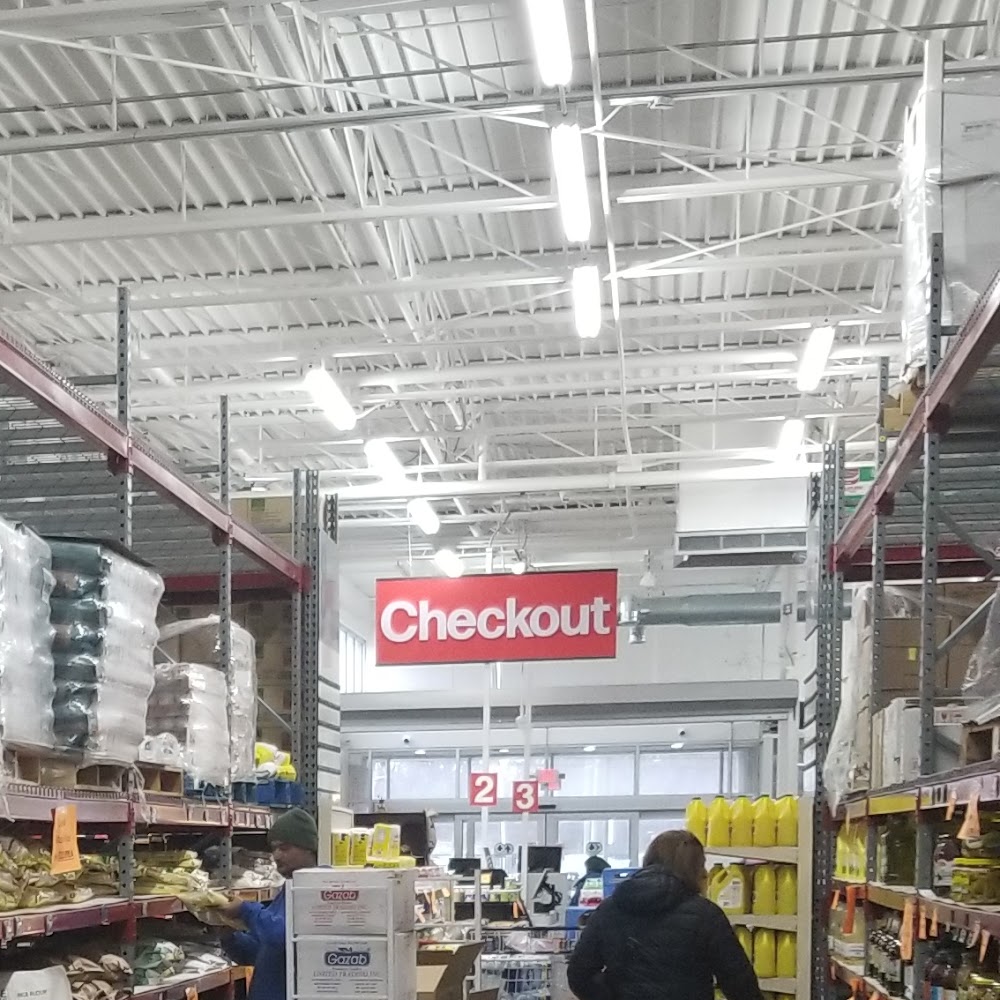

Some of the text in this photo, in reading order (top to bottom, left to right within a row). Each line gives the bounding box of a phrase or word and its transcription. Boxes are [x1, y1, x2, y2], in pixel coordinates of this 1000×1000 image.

[380, 596, 611, 643] Checkout
[473, 775, 494, 803] 2
[515, 783, 535, 810] 3
[323, 890, 358, 900] Gazab
[327, 952, 368, 965] Gazab
